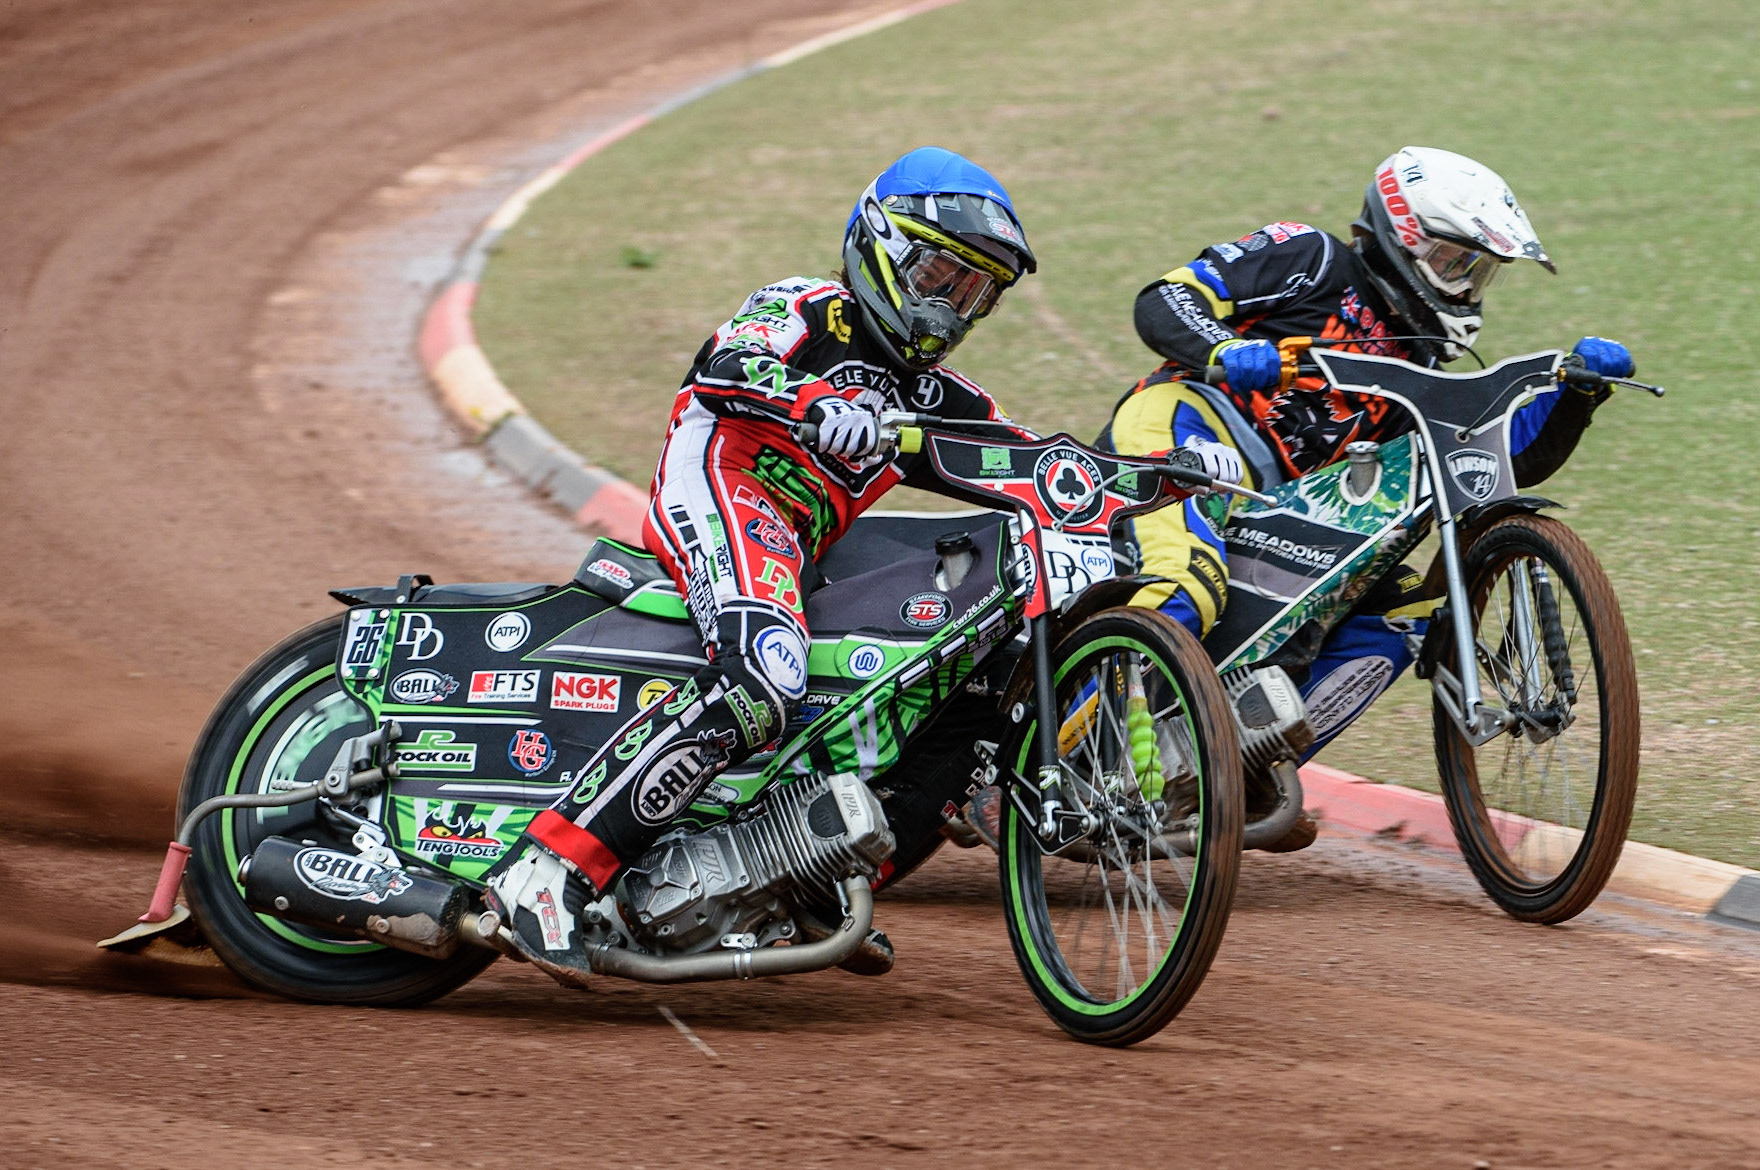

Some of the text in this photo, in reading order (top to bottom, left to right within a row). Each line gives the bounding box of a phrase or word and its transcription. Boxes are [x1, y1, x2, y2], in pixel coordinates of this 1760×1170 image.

[1378, 166, 1427, 247] 100%
[1038, 450, 1100, 483] BELLE VUE ACES
[1473, 474, 1493, 495] 14
[1238, 528, 1338, 565] MEADOWS
[1044, 550, 1091, 594] DD
[1086, 557, 1108, 569] ATPI
[909, 604, 943, 616] STS
[953, 585, 1001, 629] cwr26.co.uk
[346, 625, 385, 664] 26
[396, 612, 444, 661] DD
[494, 625, 521, 637] ATPI
[767, 641, 802, 680] ATPI
[493, 672, 537, 692] FTS
[506, 691, 532, 699] Services
[554, 674, 618, 701] NGK
[553, 700, 616, 711] SPARK PLUGS
[731, 691, 754, 722] ROCK
[441, 752, 471, 763] OIL
